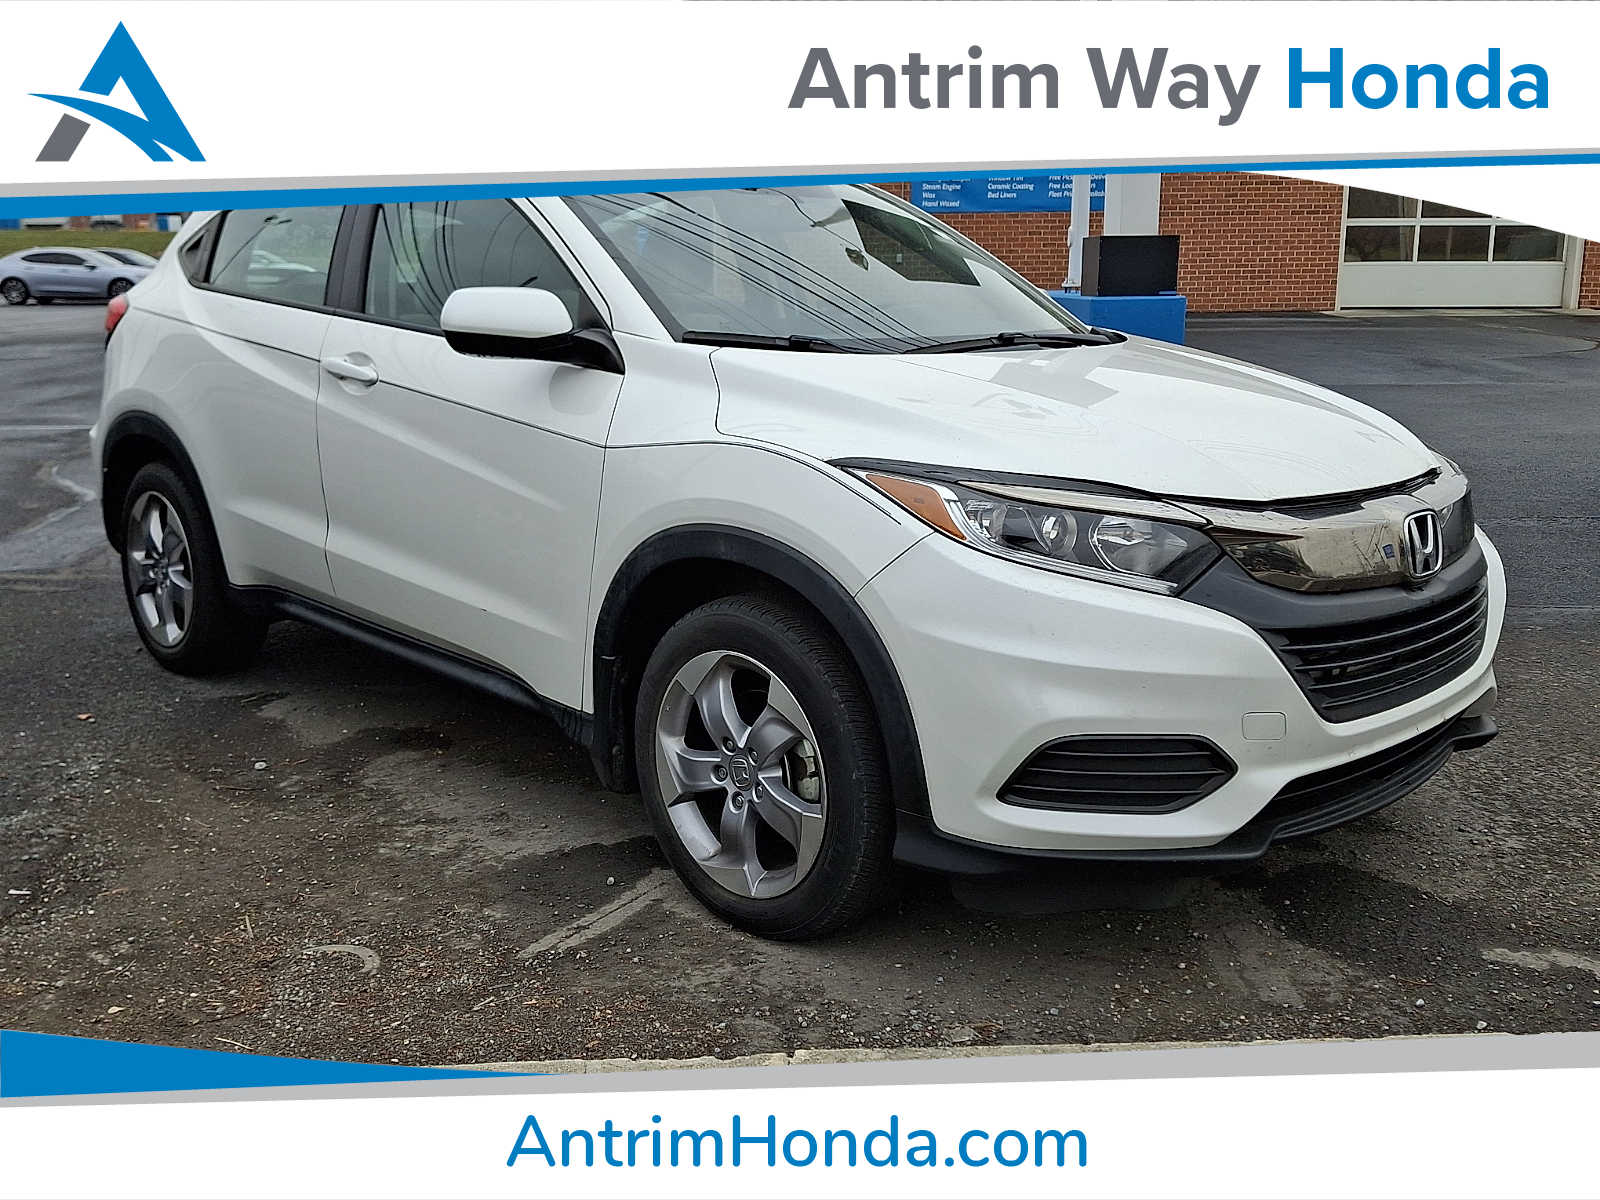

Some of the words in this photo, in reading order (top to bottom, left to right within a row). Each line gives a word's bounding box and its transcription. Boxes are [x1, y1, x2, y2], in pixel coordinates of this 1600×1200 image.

[942, 183, 962, 191] Engine
[987, 182, 1011, 190] Ceramic
[1012, 182, 1034, 191] Coating
[922, 191, 936, 199] Wax
[987, 191, 1000, 199] Bed
[1000, 191, 1017, 199] Liners
[922, 199, 939, 207] Hand
